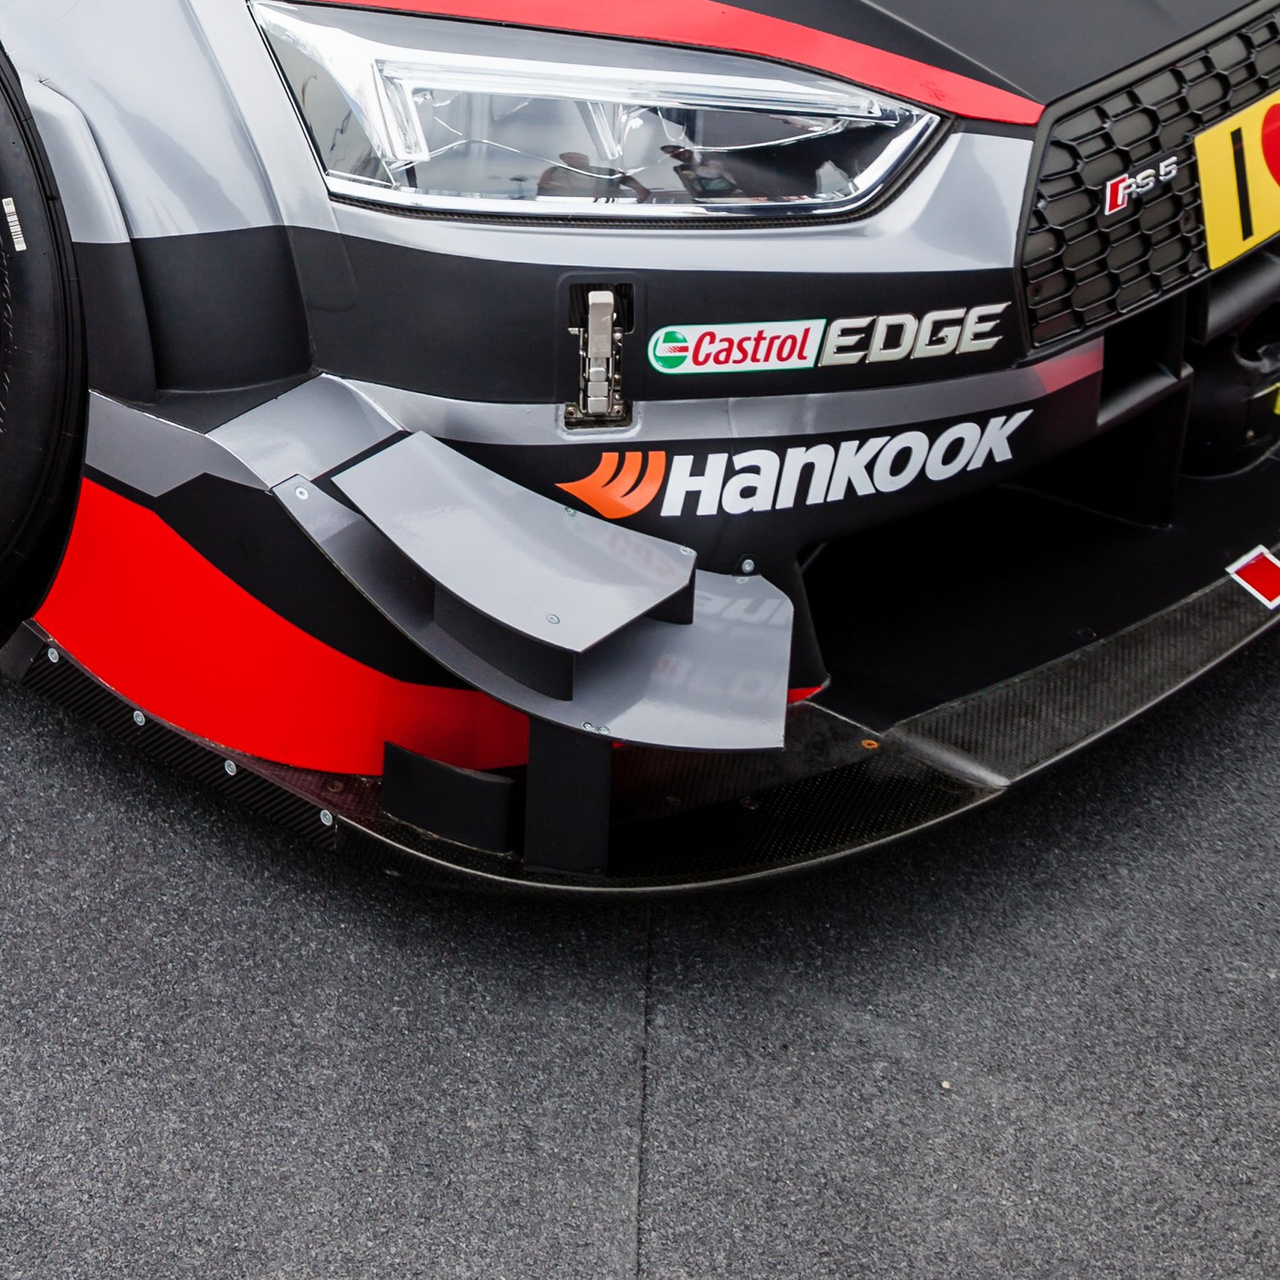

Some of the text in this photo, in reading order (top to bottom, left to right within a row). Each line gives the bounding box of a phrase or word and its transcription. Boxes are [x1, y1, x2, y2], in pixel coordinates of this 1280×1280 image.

[1116, 156, 1178, 205] RS 5
[688, 301, 1012, 366] Castrol EDGE
